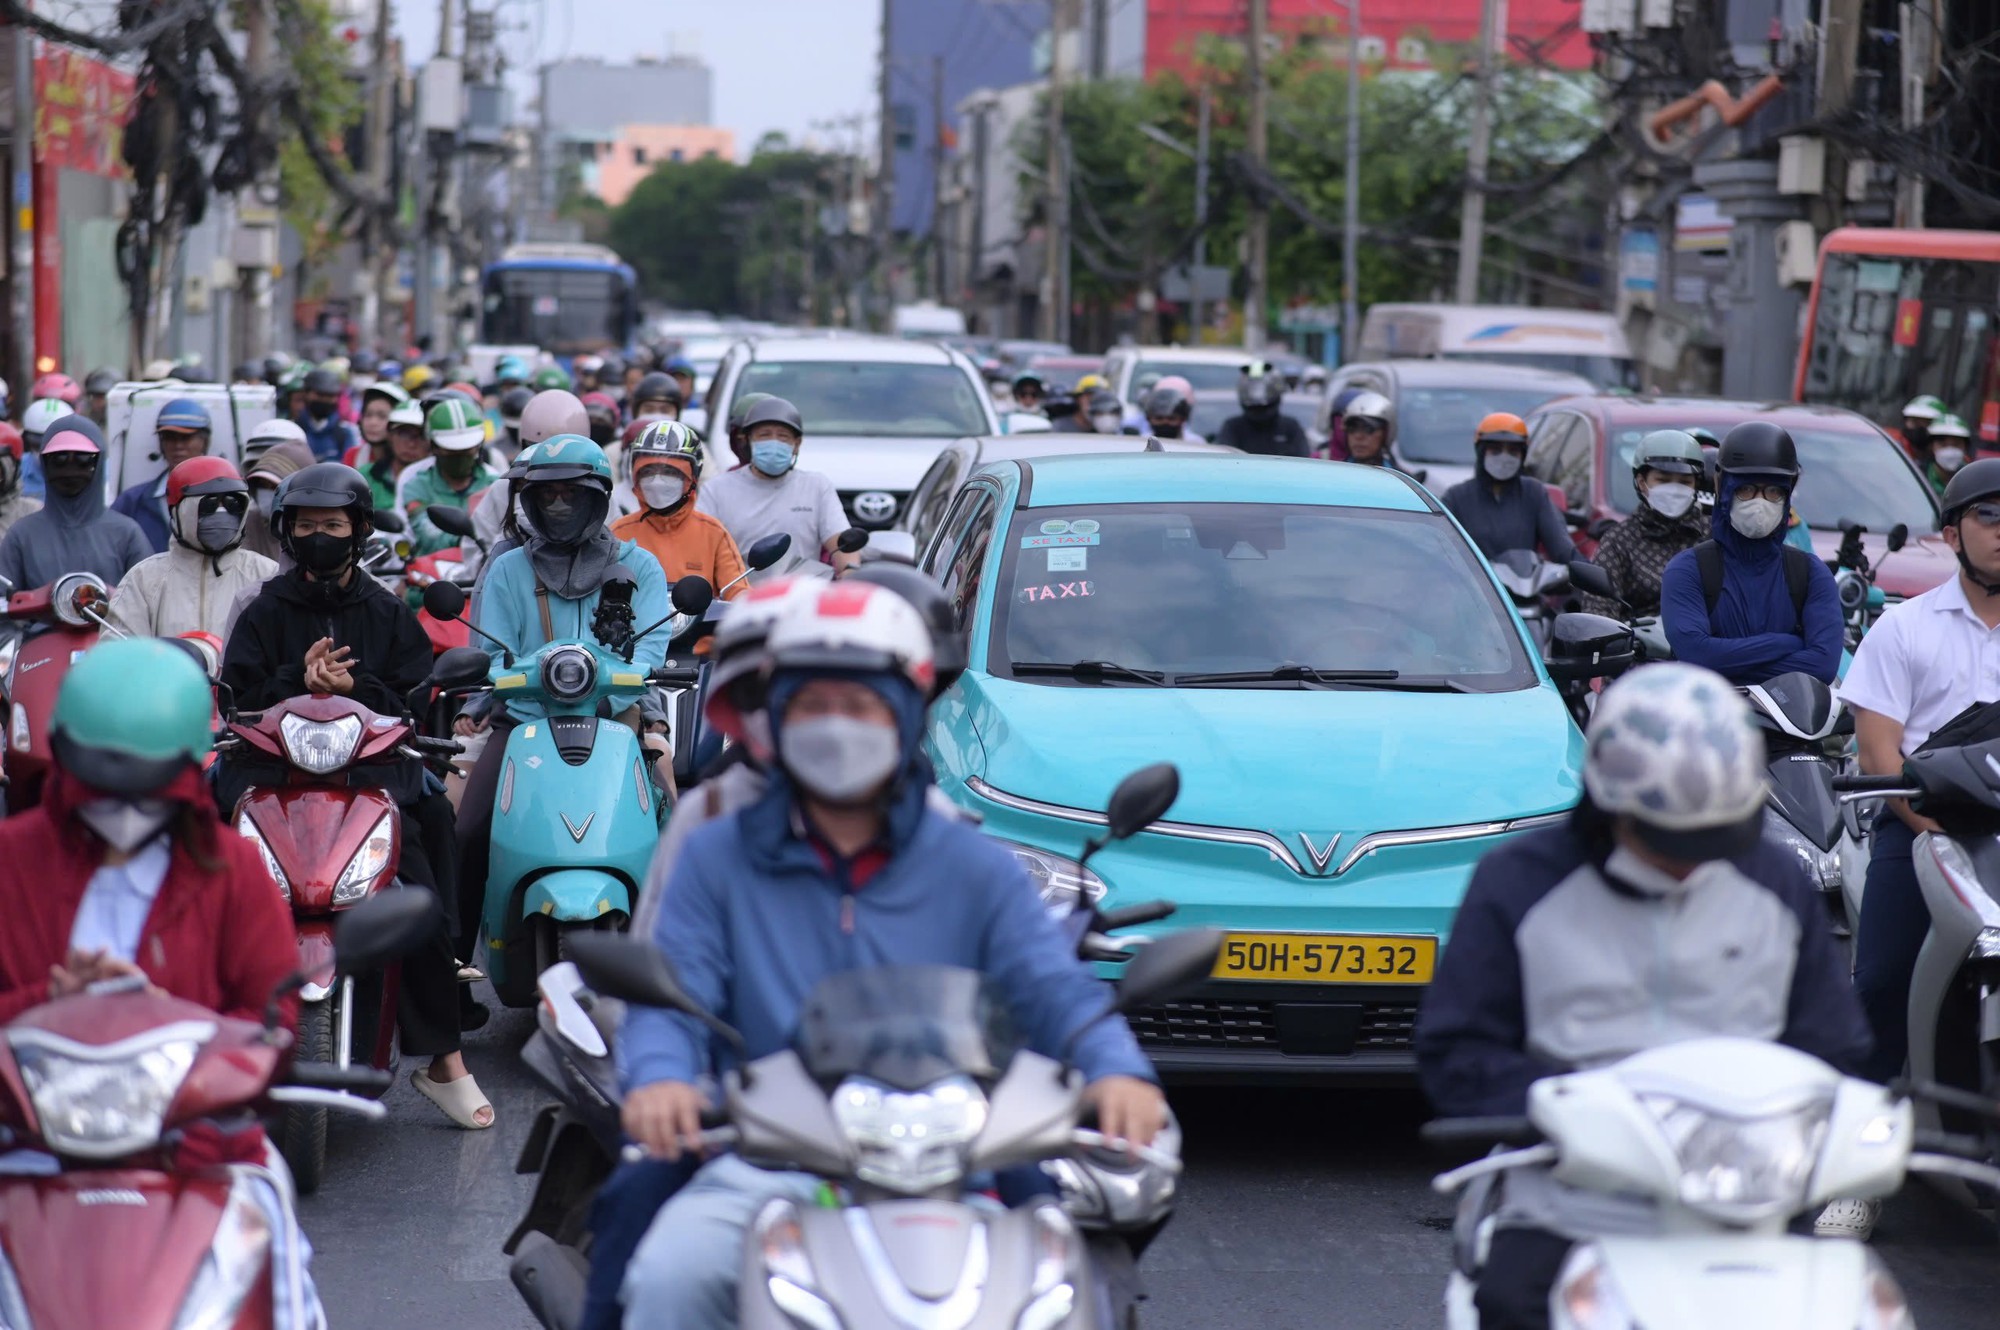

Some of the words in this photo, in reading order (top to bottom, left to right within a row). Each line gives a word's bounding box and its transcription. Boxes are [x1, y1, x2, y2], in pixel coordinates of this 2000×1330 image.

[1056, 536, 1092, 544] TAXI
[1023, 580, 1090, 602] TAXI
[1227, 941, 1417, 975] 50H-573.32
